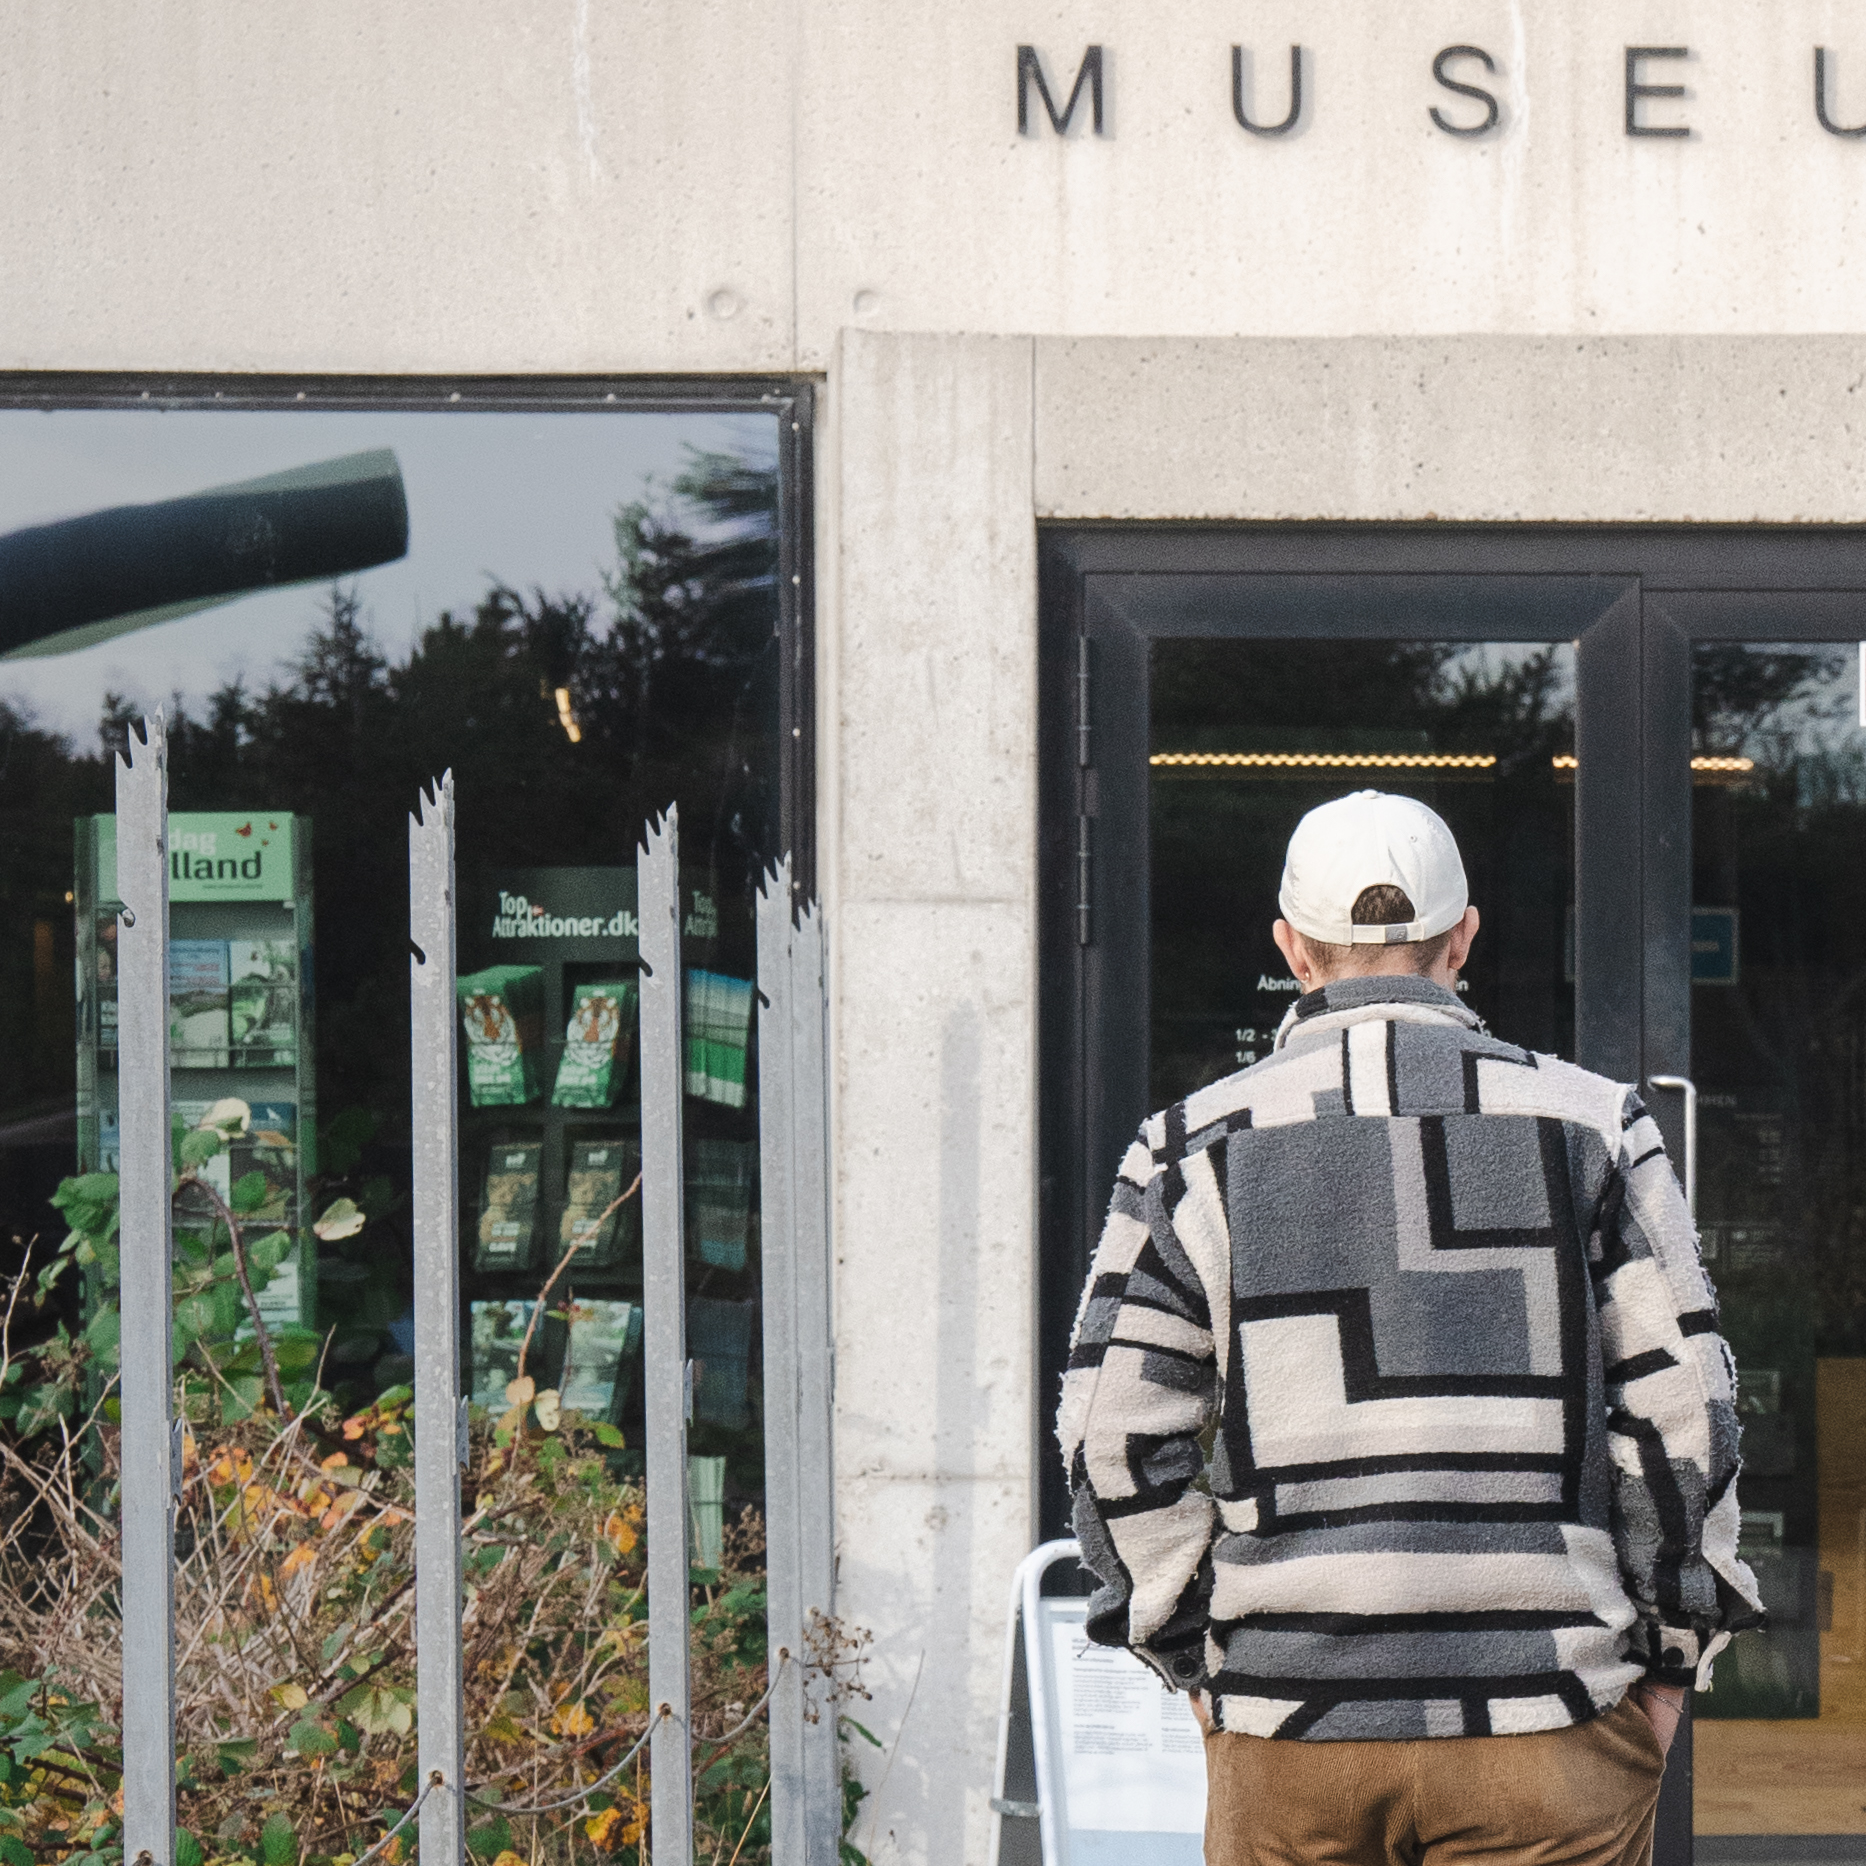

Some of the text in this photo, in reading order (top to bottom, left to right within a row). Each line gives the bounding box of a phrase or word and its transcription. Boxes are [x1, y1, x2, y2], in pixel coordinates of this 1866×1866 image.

[171, 850, 262, 880] lland
[499, 890, 529, 921] Top
[492, 905, 639, 938] Attraktioner.dk
[1235, 1028, 1257, 1043] 1/2
